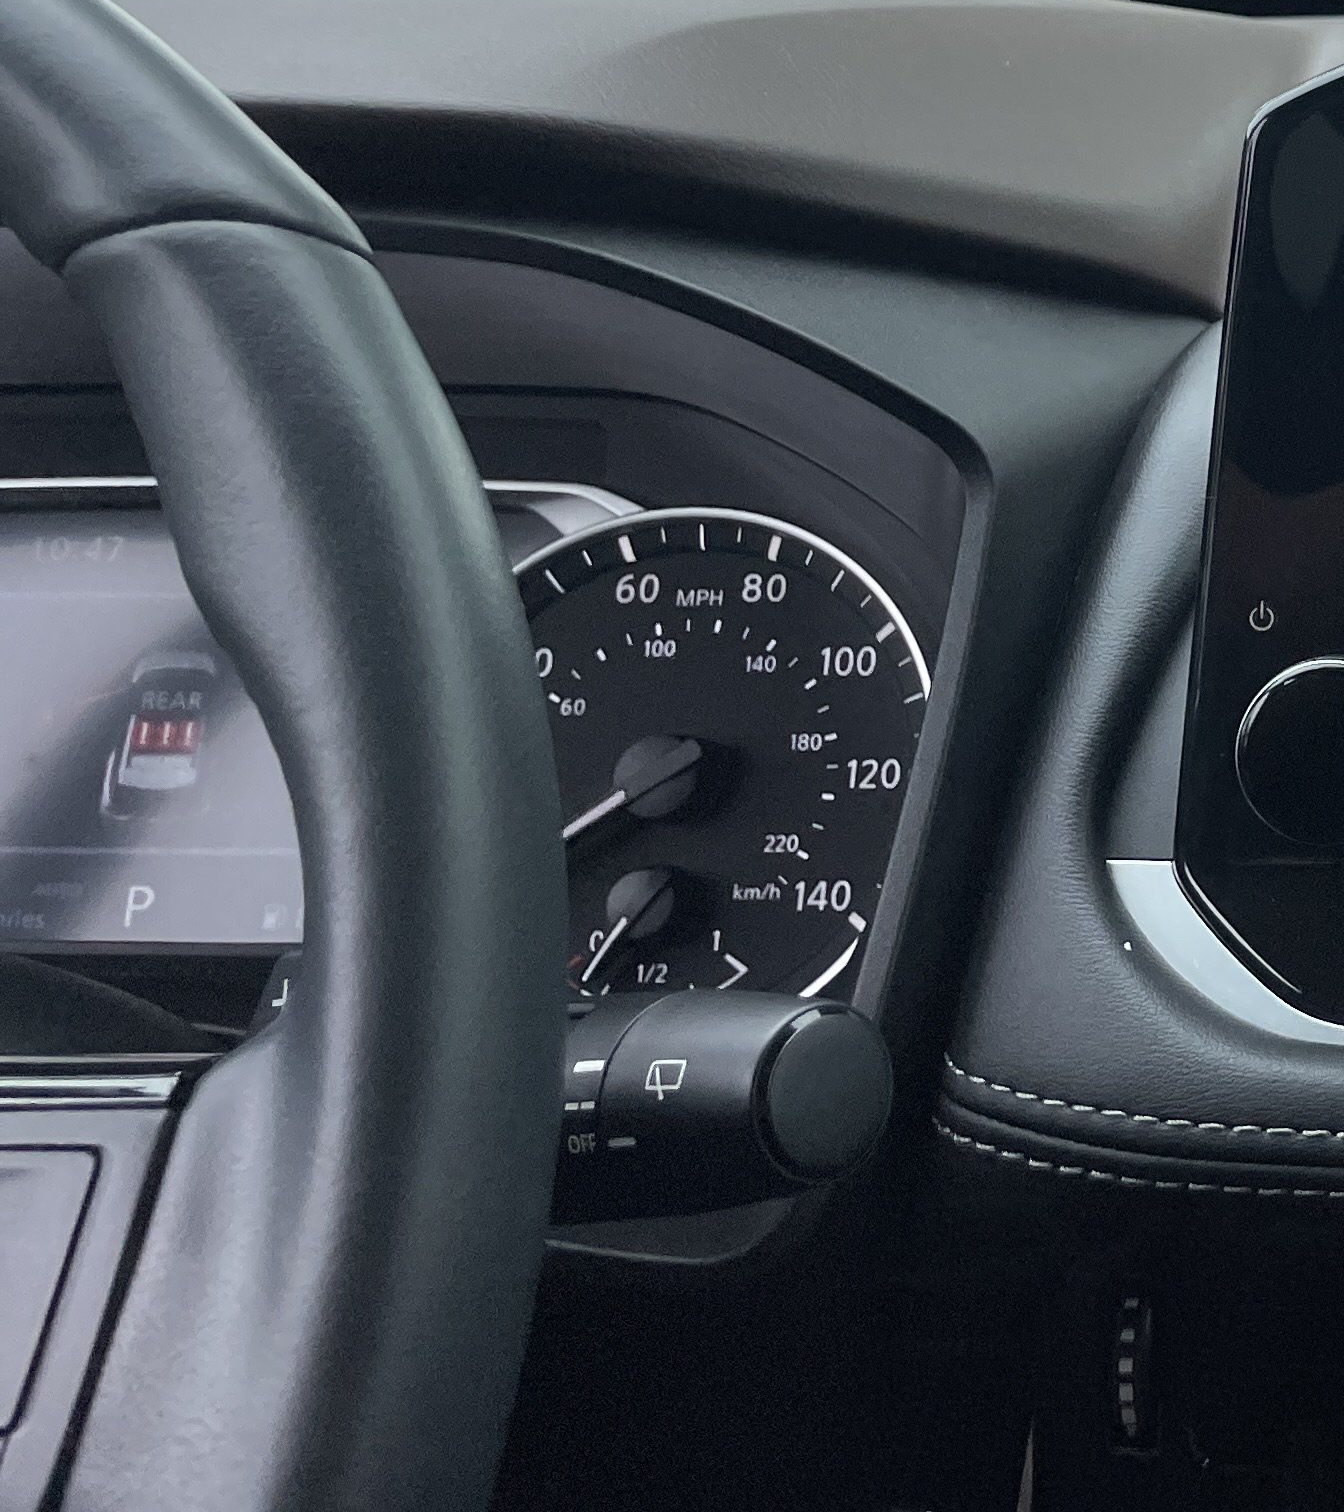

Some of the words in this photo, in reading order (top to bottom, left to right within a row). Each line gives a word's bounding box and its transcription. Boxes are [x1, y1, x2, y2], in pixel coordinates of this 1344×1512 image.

[615, 574, 660, 604] 60
[676, 589, 724, 607] MPH
[741, 573, 787, 603] 80
[645, 640, 676, 657] 100
[746, 655, 777, 673] 140
[821, 646, 877, 677] 100
[560, 699, 586, 716] 60
[791, 733, 823, 751] 180
[847, 758, 901, 789] 120
[763, 834, 799, 855] 220
[732, 883, 781, 900] km/h
[795, 880, 851, 912] 140
[124, 885, 155, 927] P
[637, 963, 668, 984] 1/2
[567, 1132, 596, 1154] OFF
